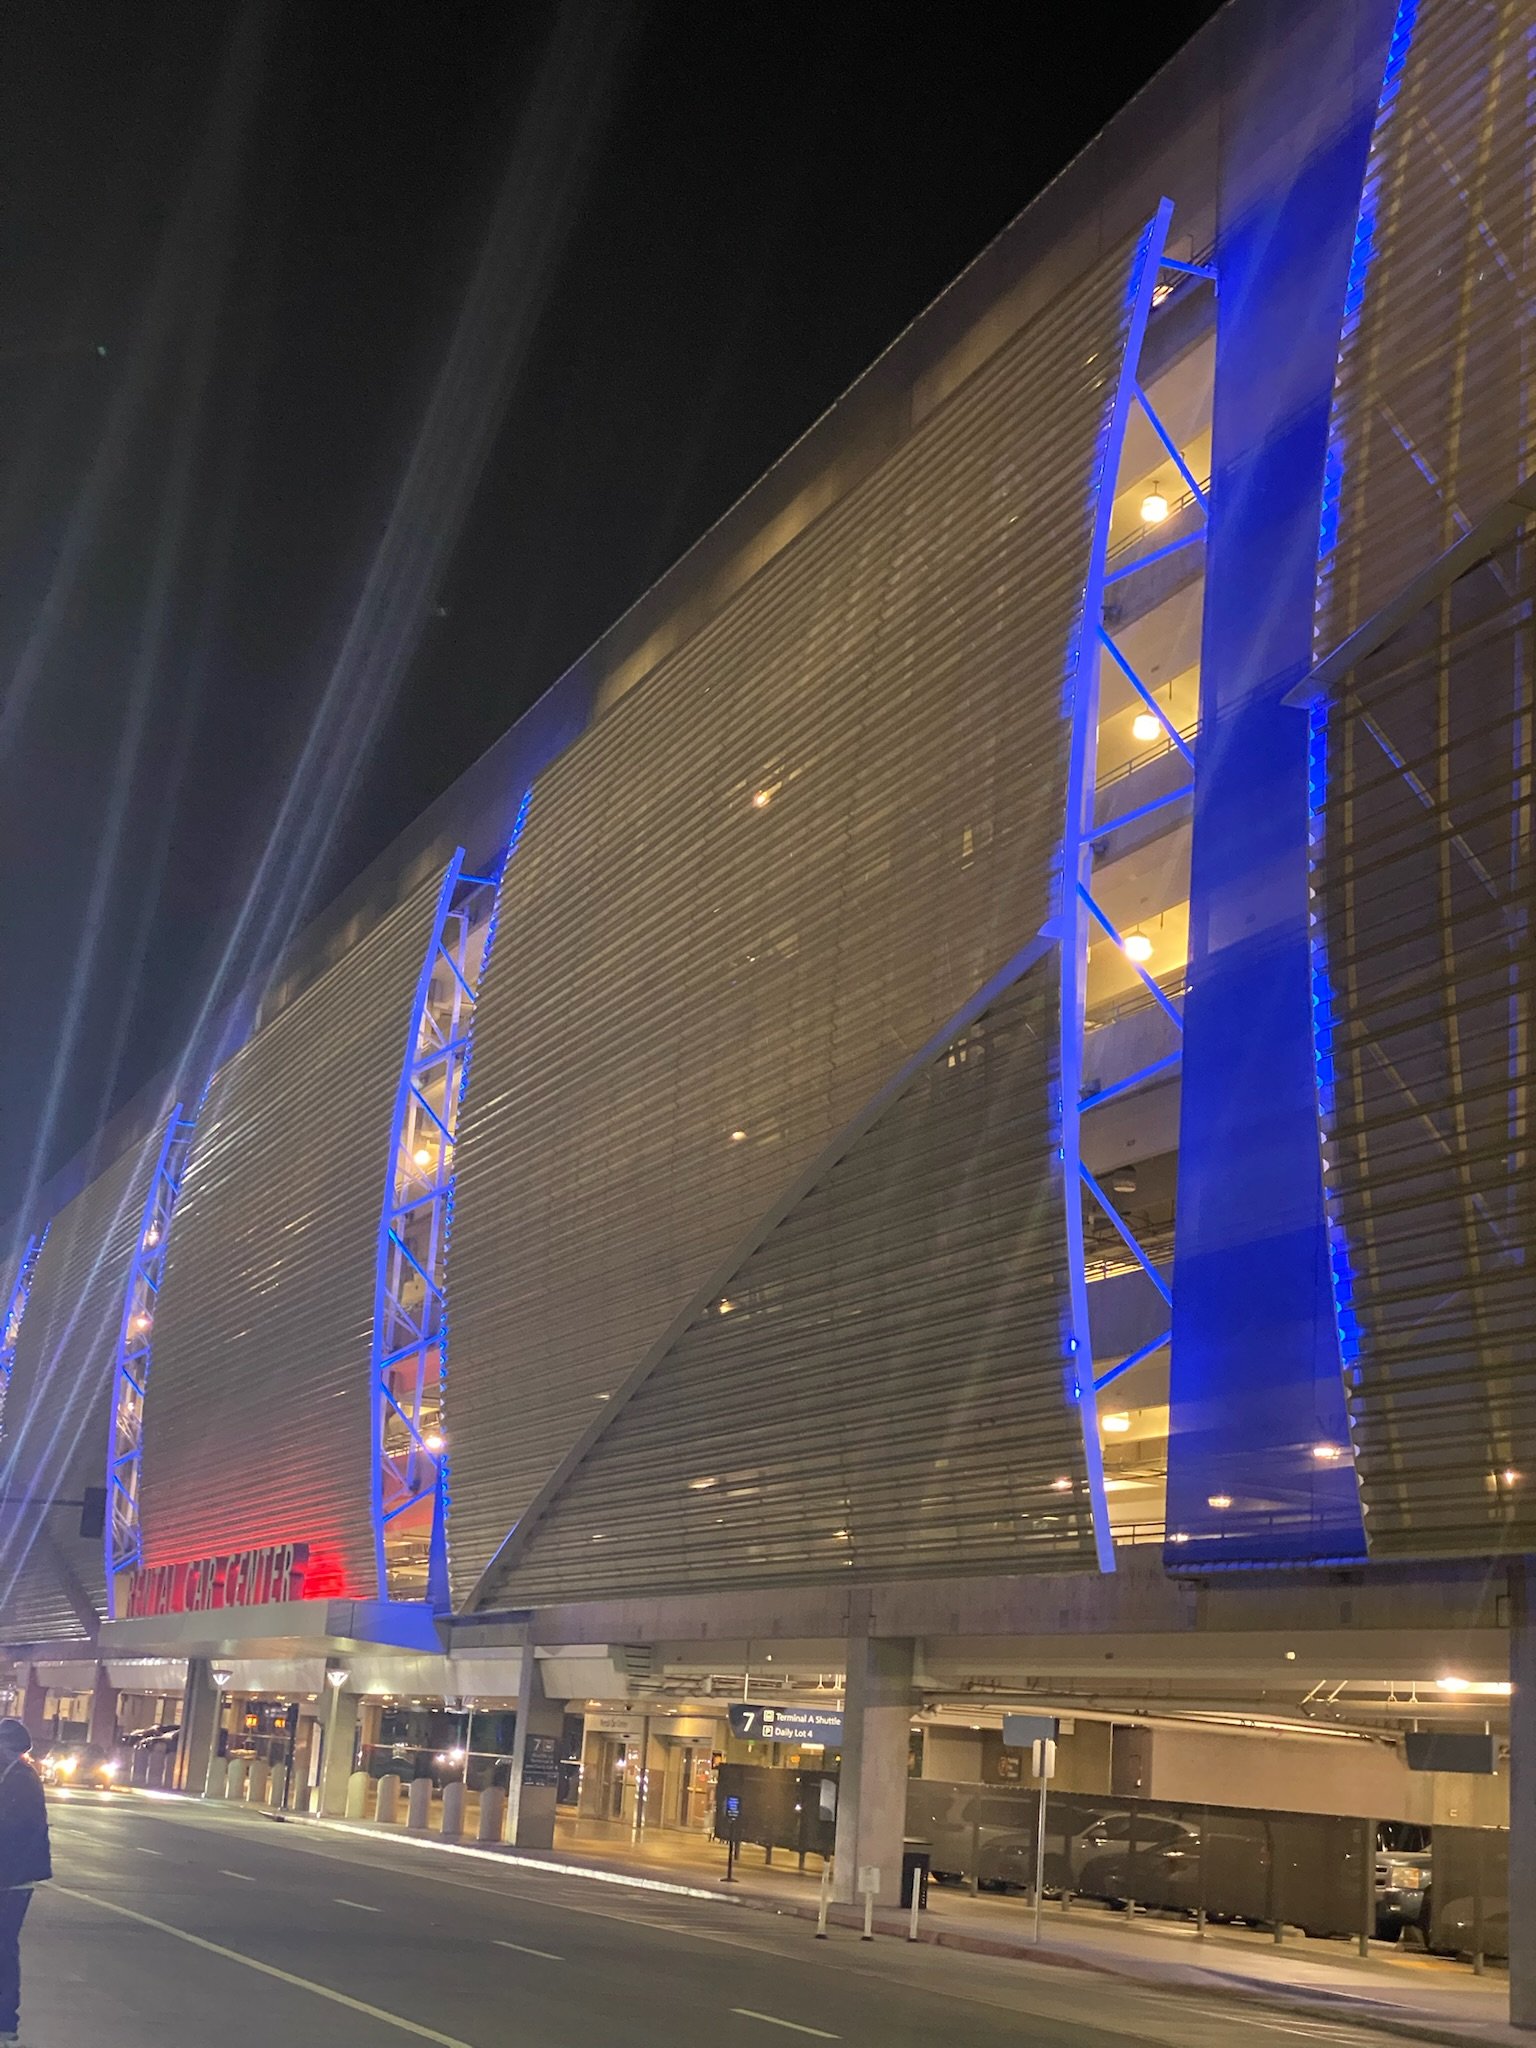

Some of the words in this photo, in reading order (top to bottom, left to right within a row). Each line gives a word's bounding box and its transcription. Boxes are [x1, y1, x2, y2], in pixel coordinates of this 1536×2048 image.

[127, 1563, 176, 1618] RENTAL
[183, 1557, 216, 1612] CAR
[223, 1543, 294, 1608] CENTER
[743, 1712, 755, 1732] 7
[776, 1713, 806, 1724] Terminal
[808, 1715, 814, 1724] A
[815, 1716, 841, 1726] Shuttle
[775, 1728, 793, 1738] Daily
[794, 1730, 806, 1738] Lot
[807, 1730, 813, 1738] 4
[533, 1738, 541, 1751] 7
